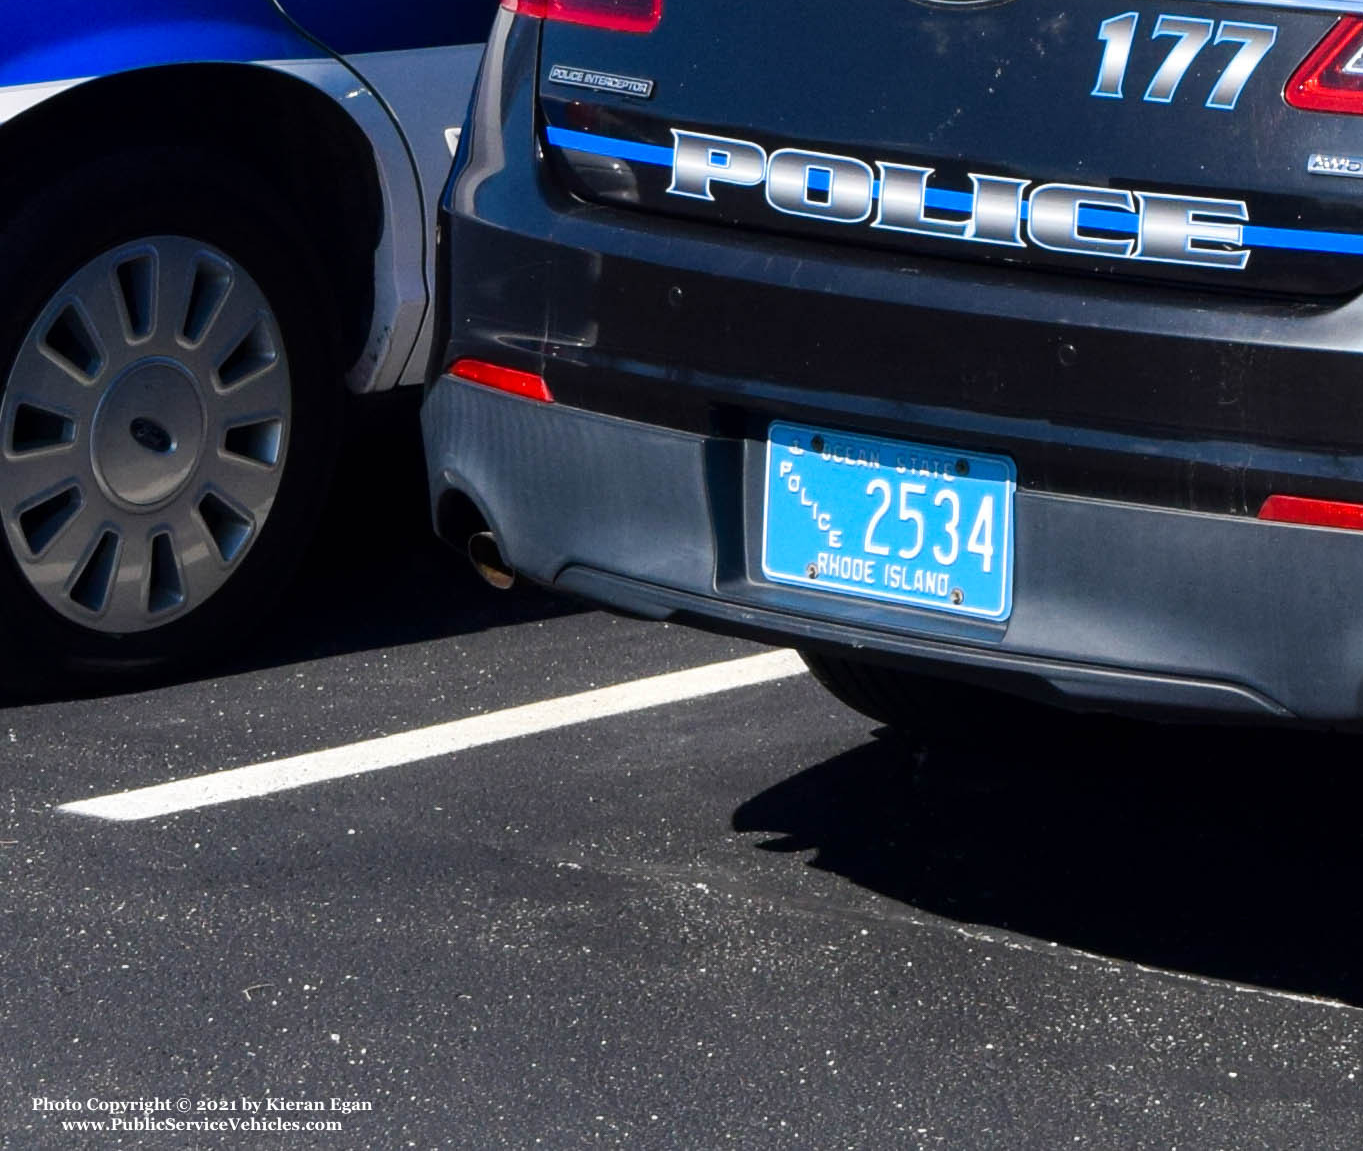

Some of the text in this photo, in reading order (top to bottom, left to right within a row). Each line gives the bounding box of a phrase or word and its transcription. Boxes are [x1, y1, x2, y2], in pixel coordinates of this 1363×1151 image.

[551, 68, 648, 93] POLICE INTERCEPTOR
[1090, 11, 1278, 110] 177
[665, 128, 1251, 270] POLICE
[778, 461, 844, 548] POLICE
[823, 443, 957, 481] OCEAN STATE
[863, 479, 995, 573] 2534
[817, 552, 949, 597] RHODE ISLAND
